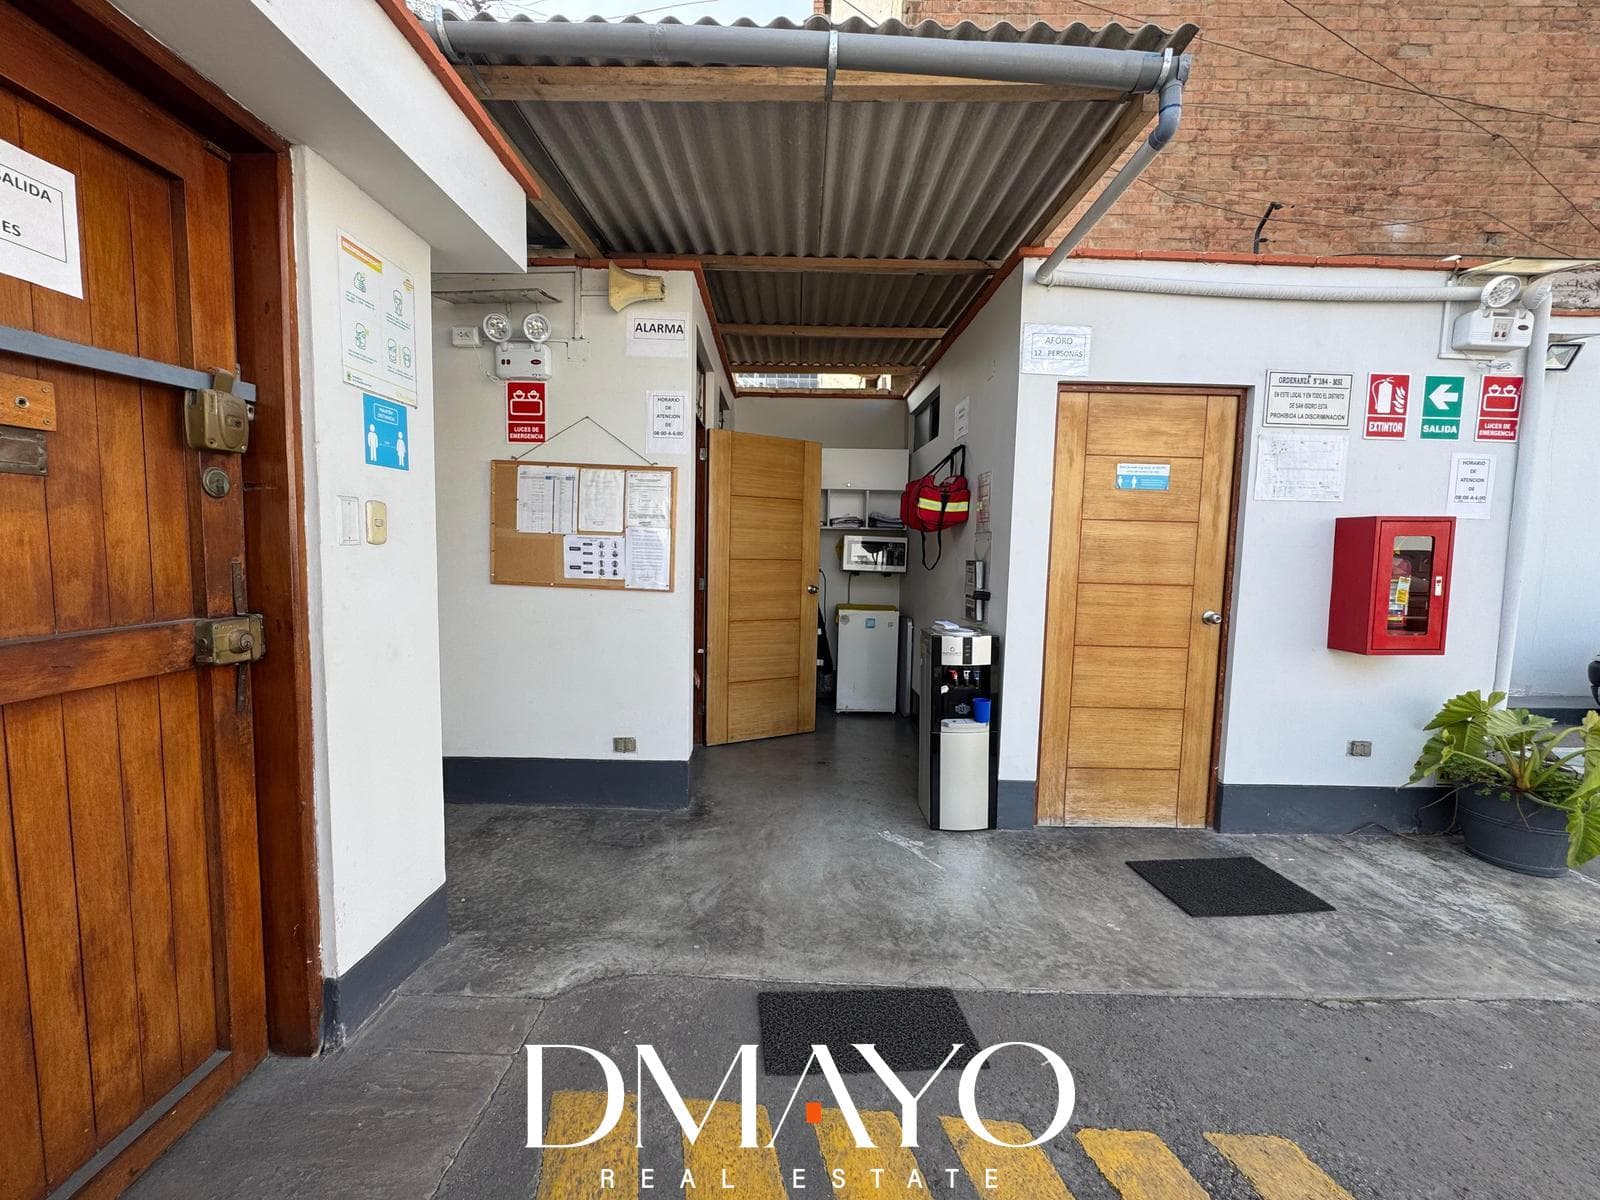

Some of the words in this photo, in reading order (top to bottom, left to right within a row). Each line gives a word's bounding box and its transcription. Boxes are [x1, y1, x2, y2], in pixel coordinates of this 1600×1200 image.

[0, 172, 52, 204] ALIDA
[635, 322, 684, 334] ALARMA
[1045, 336, 1073, 345] AFORO
[1047, 350, 1083, 358] PERSONAS
[1278, 376, 1310, 385] ORDENANZA
[1280, 391, 1290, 399] ESTE
[1368, 421, 1403, 433] EXTINTOR
[1422, 424, 1458, 434] SALIDA
[1478, 429, 1515, 437] EMERGENCIA
